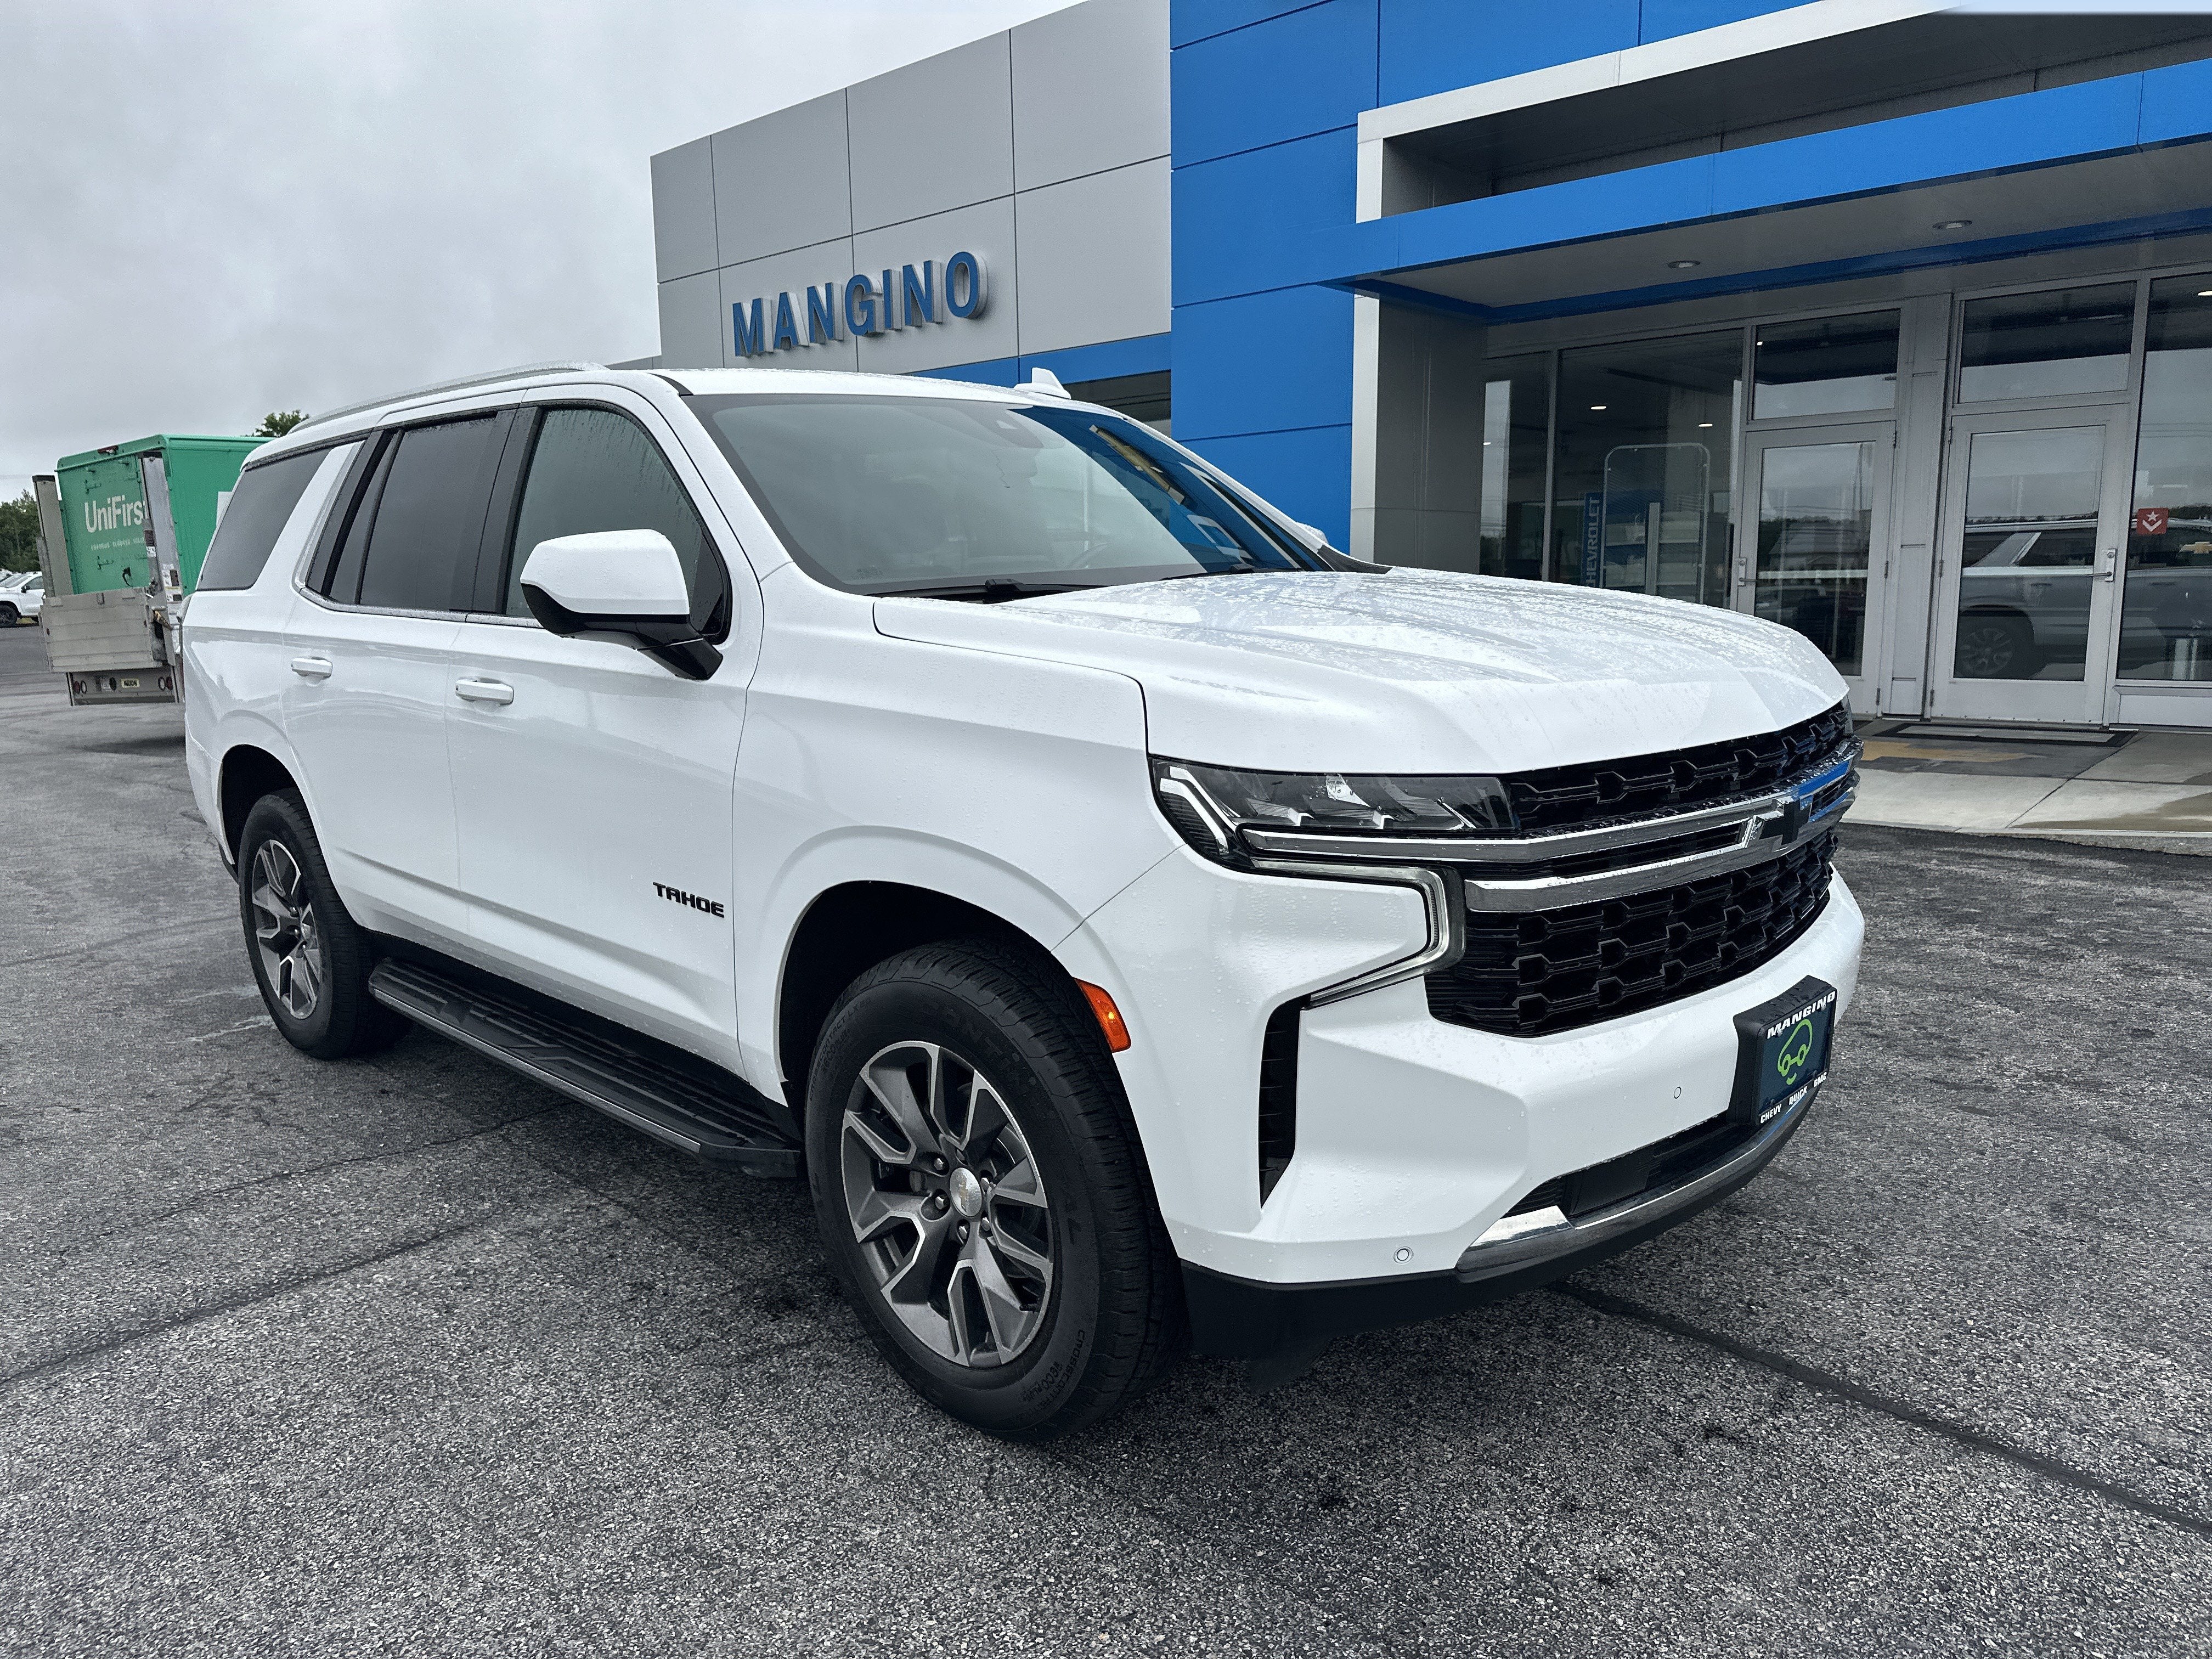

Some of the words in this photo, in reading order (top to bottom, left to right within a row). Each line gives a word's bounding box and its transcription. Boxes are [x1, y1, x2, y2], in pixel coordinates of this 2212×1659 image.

[732, 251, 986, 357] MANGINO
[1586, 497, 1599, 587] HEVROLET
[652, 882, 725, 918] TAHOE
[1767, 991, 1836, 1039] MANGINO
[1760, 1103, 1782, 1124] CHEVY
[1788, 1086, 1808, 1105] BUICK
[1813, 1071, 1827, 1087] GMC
